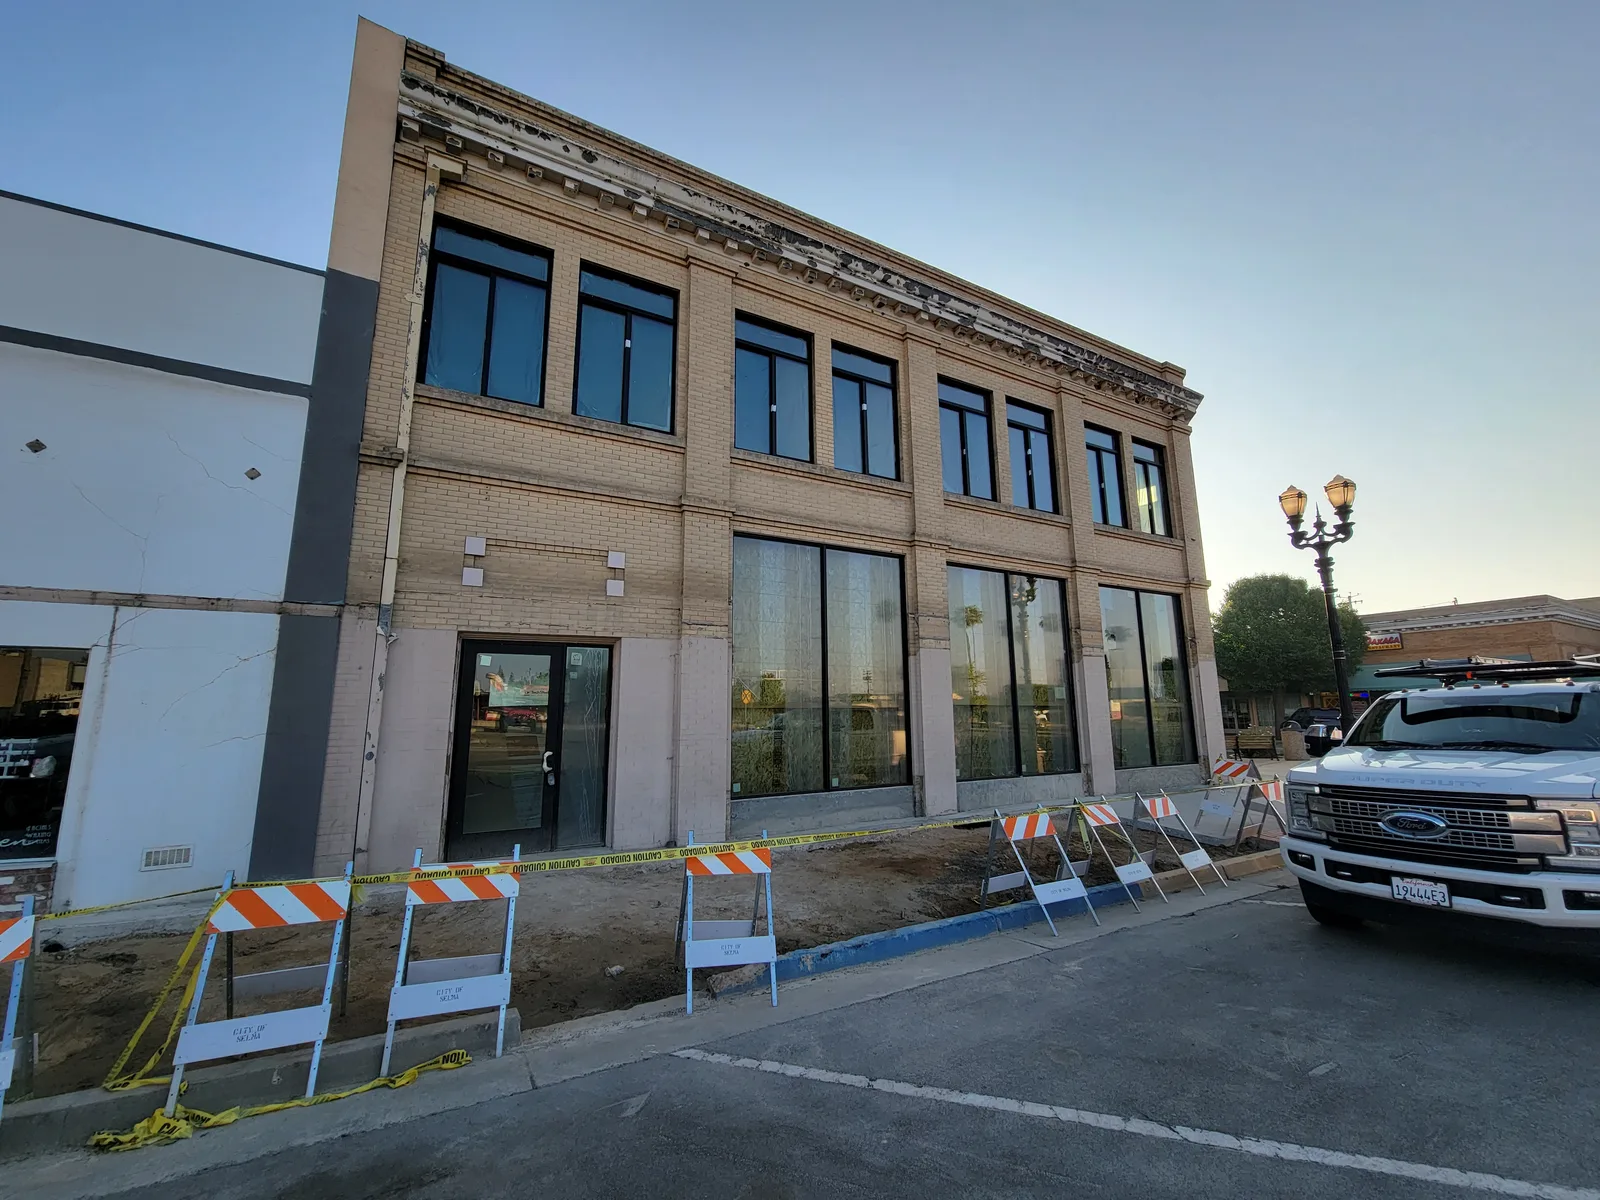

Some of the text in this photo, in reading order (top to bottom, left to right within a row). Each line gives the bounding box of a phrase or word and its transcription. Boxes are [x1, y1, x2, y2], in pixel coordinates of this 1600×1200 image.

[1420, 778, 1486, 788] DUTY
[1397, 817, 1427, 830] Ford
[751, 837, 800, 848] CAUTION CUIDADO
[679, 843, 735, 857] CAUTION CUIDADO
[600, 851, 662, 865] CAUTION CUIDADO
[512, 859, 581, 873] CAUTION CUIDADO
[455, 867, 490, 877] CAUTION
[1396, 885, 1446, 903] 19444E3
[436, 987, 453, 996] CITY
[232, 1026, 254, 1036] CITY
[236, 1032, 261, 1043] SELMA
